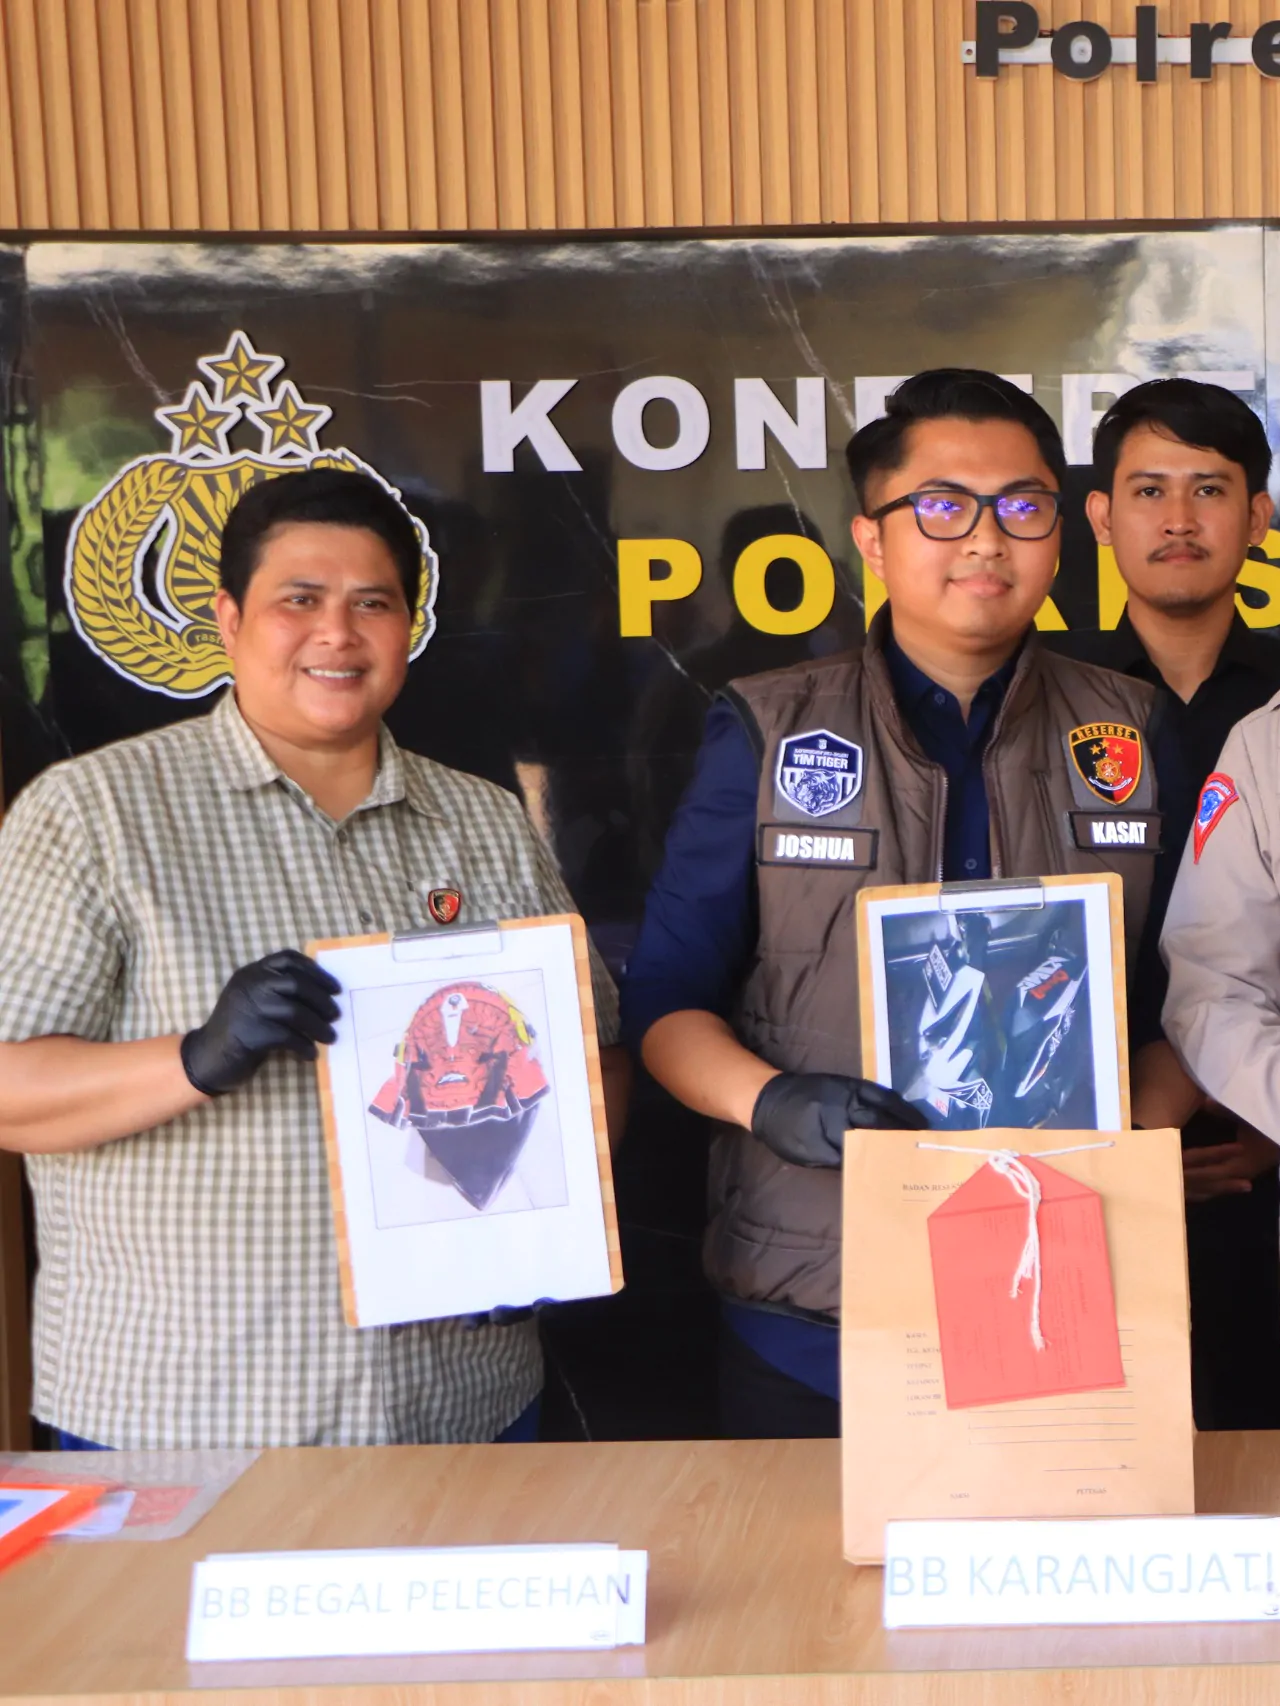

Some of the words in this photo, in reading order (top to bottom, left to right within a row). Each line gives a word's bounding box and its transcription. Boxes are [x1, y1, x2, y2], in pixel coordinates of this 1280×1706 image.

[1077, 725, 1132, 740] RESERSE
[793, 753, 815, 766] TIM
[816, 755, 849, 769] TIGER
[1092, 821, 1148, 845] KASAT
[775, 834, 855, 861] JOSHUA
[888, 1555, 948, 1596] BB
[200, 1586, 251, 1619] BB
[266, 1582, 392, 1617] BEGAL
[407, 1573, 631, 1613] PELECEHAN
